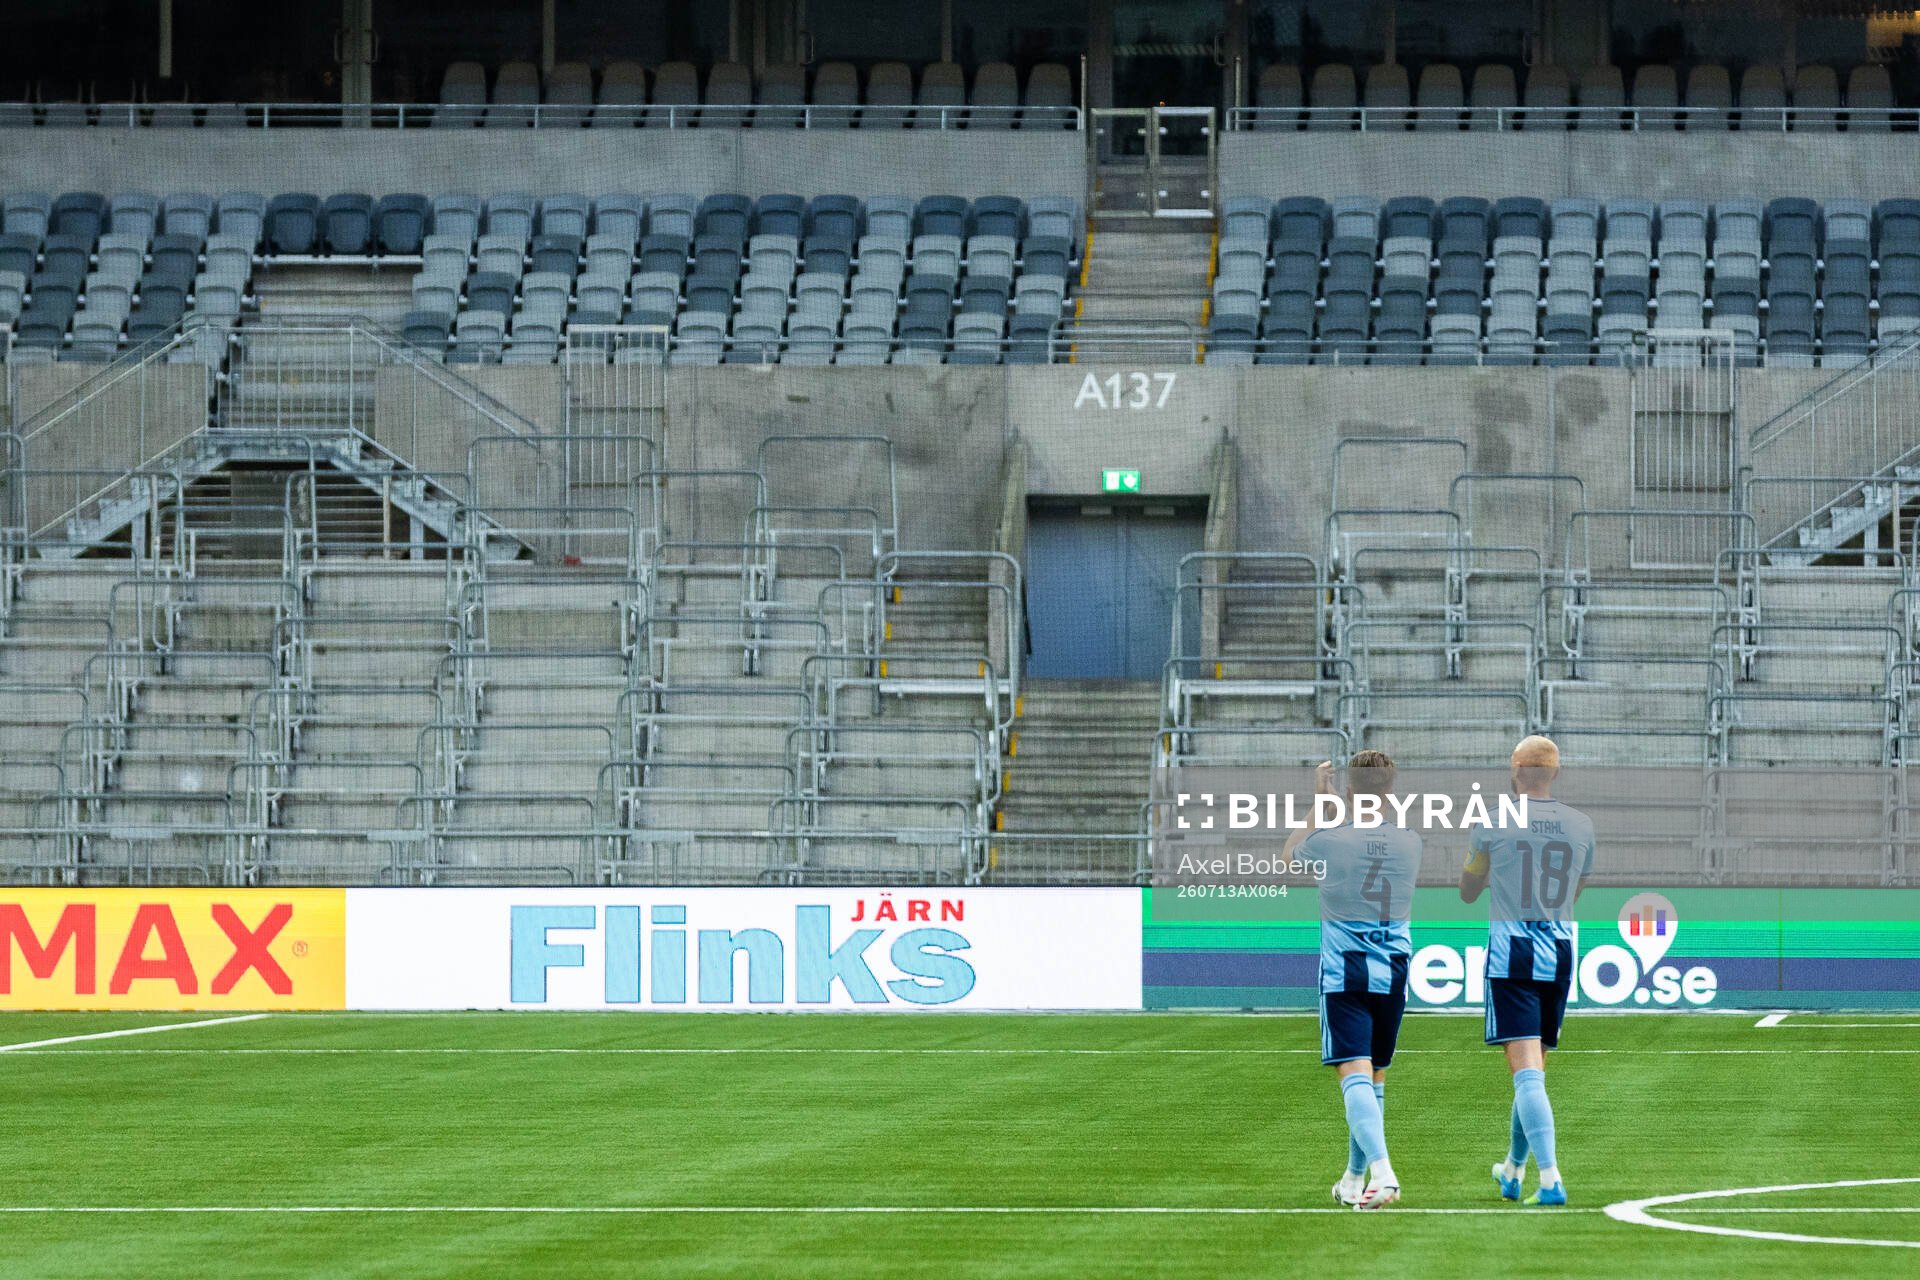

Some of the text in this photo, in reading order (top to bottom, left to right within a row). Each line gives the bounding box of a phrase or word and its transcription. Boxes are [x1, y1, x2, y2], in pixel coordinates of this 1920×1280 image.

[1073, 372, 1177, 409] A137
[850, 893, 965, 922] JÄRN
[1360, 860, 1391, 927] 4
[1516, 840, 1573, 909] 18
[510, 905, 976, 1004] Flinks
